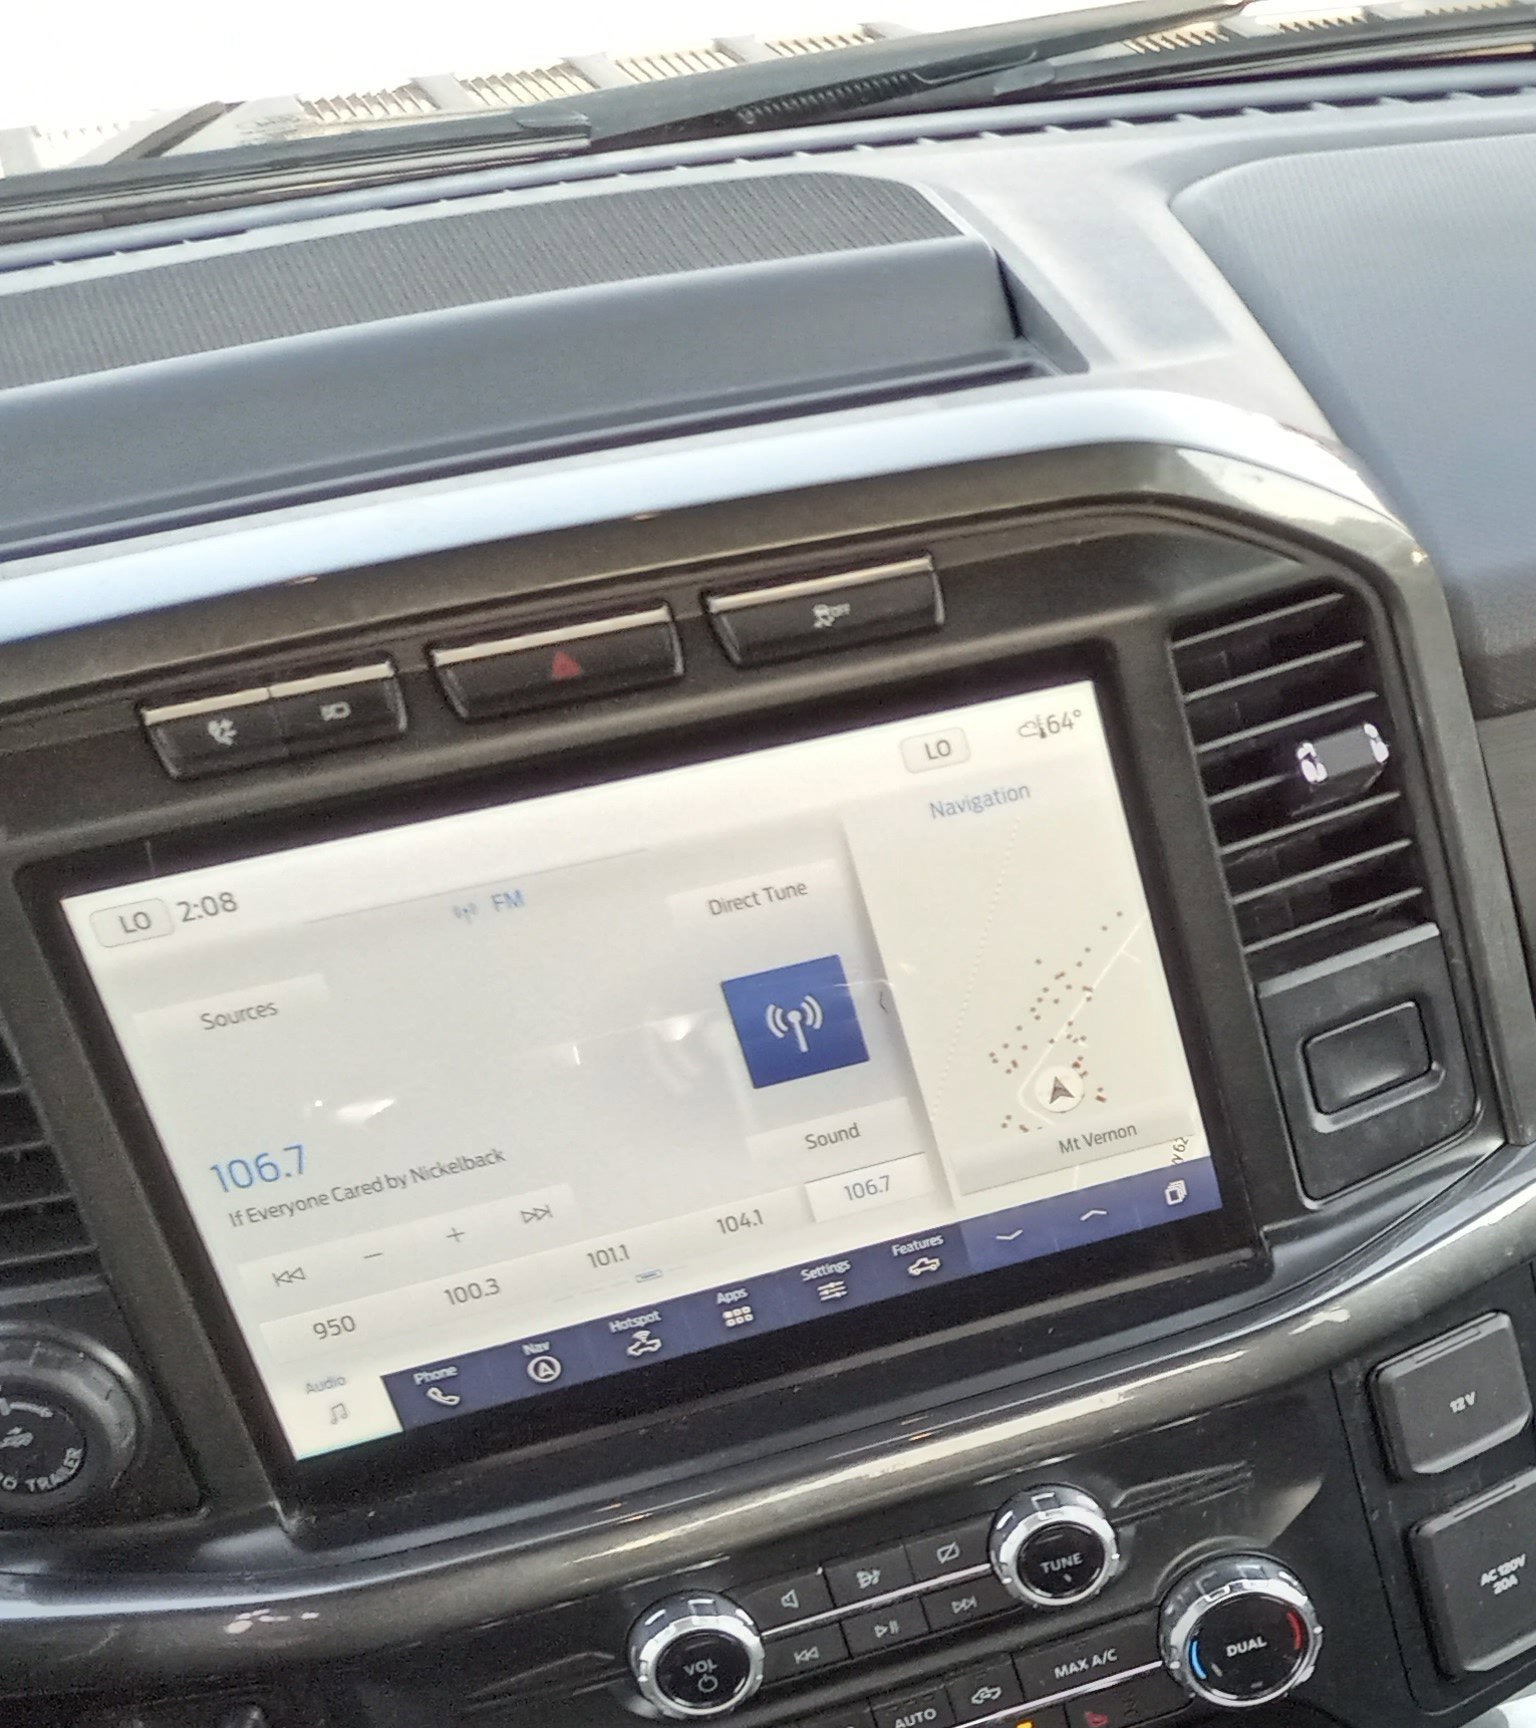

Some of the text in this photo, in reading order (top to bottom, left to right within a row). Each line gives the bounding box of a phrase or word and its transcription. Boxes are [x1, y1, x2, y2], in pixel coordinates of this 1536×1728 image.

[1047, 707, 1083, 735] 64°
[923, 738, 952, 762] LO
[929, 781, 1032, 822] Navigation
[176, 891, 238, 924] 2:08
[490, 889, 526, 914] FM
[707, 879, 809, 917] Direct Tune
[117, 909, 152, 936] LO
[200, 998, 280, 1032] Sources
[803, 1121, 861, 1151] Sound
[1058, 1120, 1138, 1155] Mt Vernon
[209, 1143, 307, 1195] 106.7
[228, 1146, 507, 1228] If Everyone Cared by Nickelback
[842, 1172, 893, 1202] 106.7
[716, 1208, 765, 1236] 104.1
[587, 1242, 631, 1270] 101.1
[892, 1232, 944, 1258] Features
[801, 1256, 851, 1282] Settings
[443, 1277, 501, 1307] 100.3
[715, 1285, 748, 1307] Apps
[312, 1313, 356, 1341] 950
[609, 1308, 662, 1335] Hotspot
[522, 1338, 551, 1356] Nav
[304, 1372, 348, 1396] Audio
[413, 1362, 458, 1386] Phone
[1040, 1552, 1084, 1575] TUNE
[1225, 1635, 1268, 1658] DUAL
[683, 1658, 718, 1677] VOL
[1054, 1647, 1118, 1680] MAX A/C
